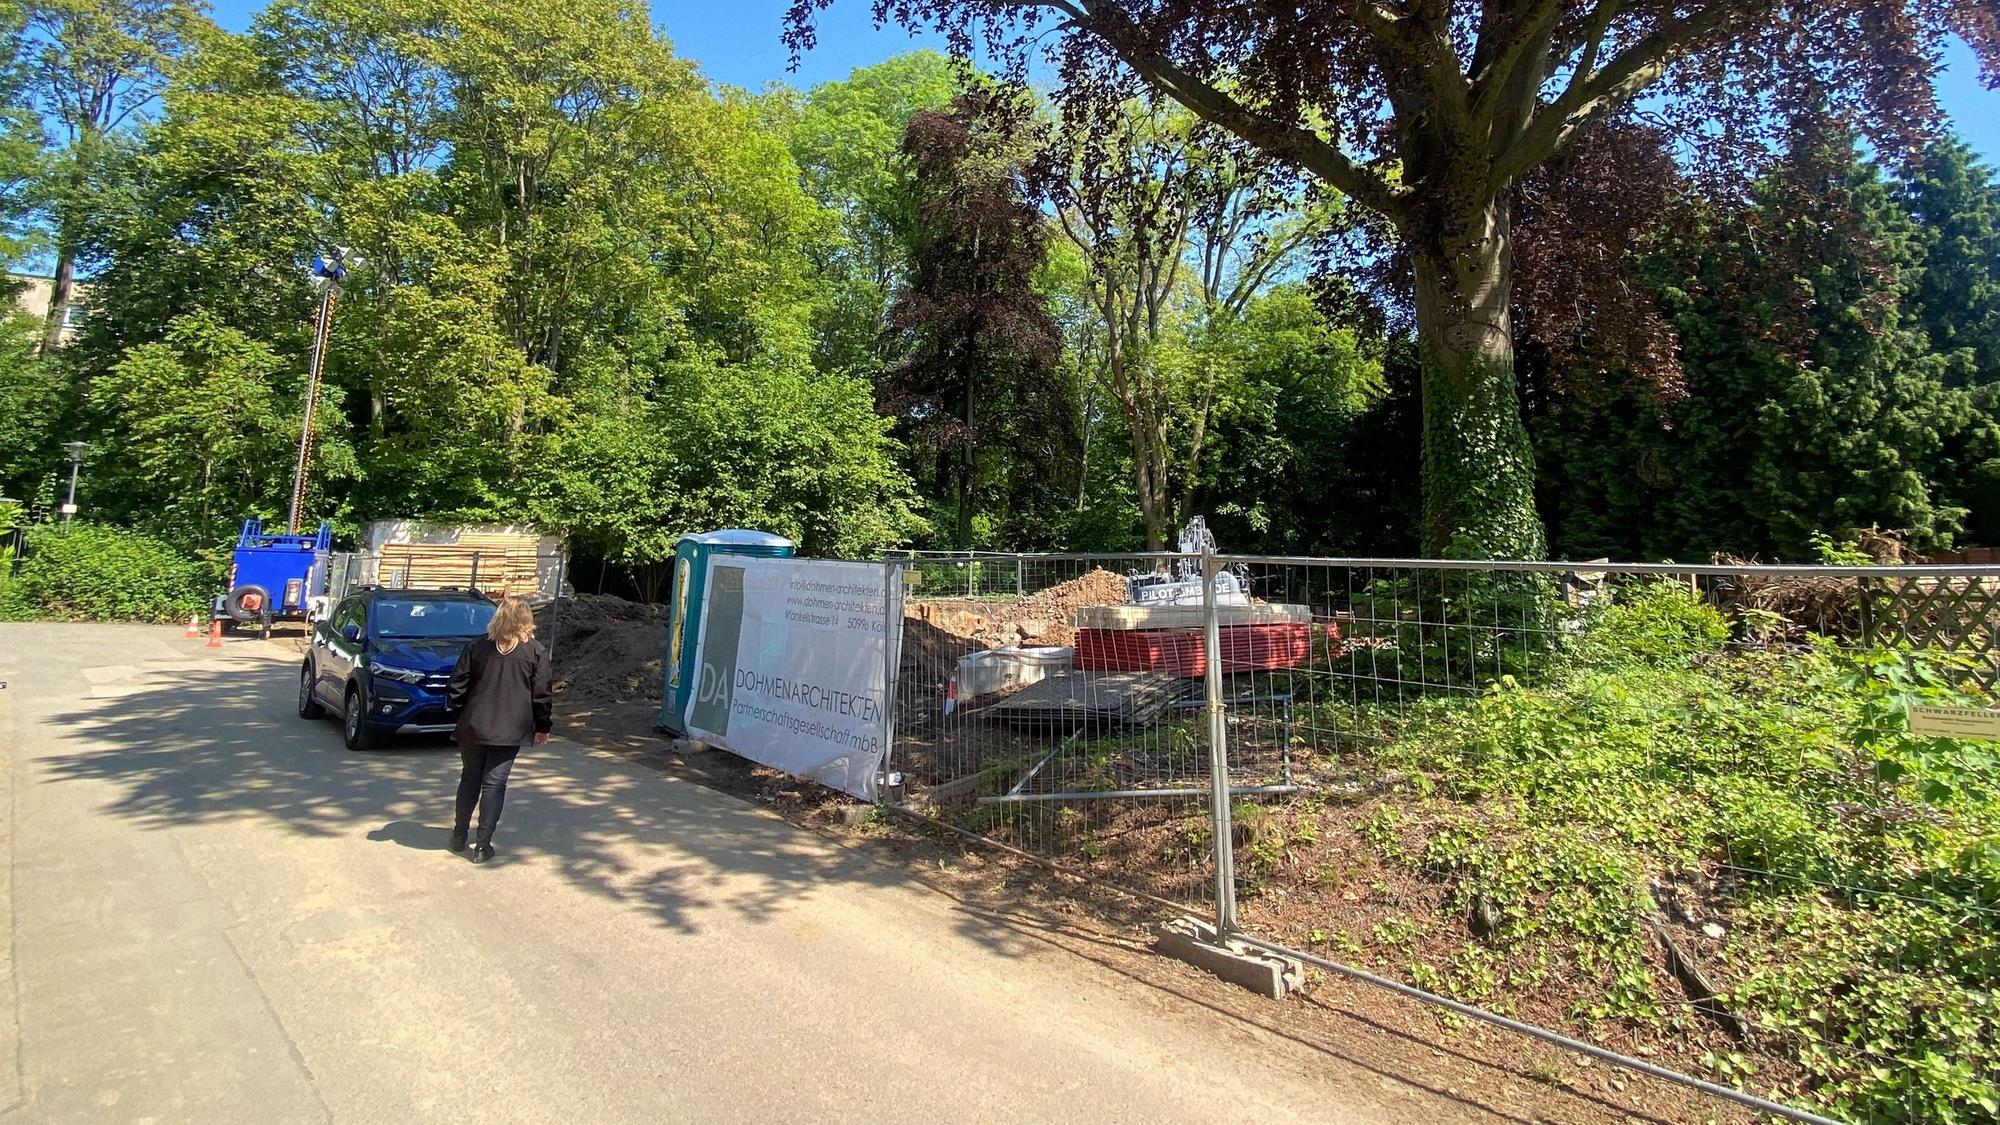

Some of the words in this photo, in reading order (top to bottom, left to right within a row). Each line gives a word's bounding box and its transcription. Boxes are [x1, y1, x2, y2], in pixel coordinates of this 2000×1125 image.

[789, 578, 886, 598] info@dohmen-architekten.d
[787, 596, 886, 615] www.dohmen-architekten.d
[847, 617, 868, 631] 50996
[871, 620, 886, 633] Köl
[699, 662, 729, 710] DA
[736, 669, 884, 724] DOHMENARCHITEKTEN
[732, 698, 850, 744] Partnerschaftsgesellschaft
[851, 734, 878, 754] mbB
